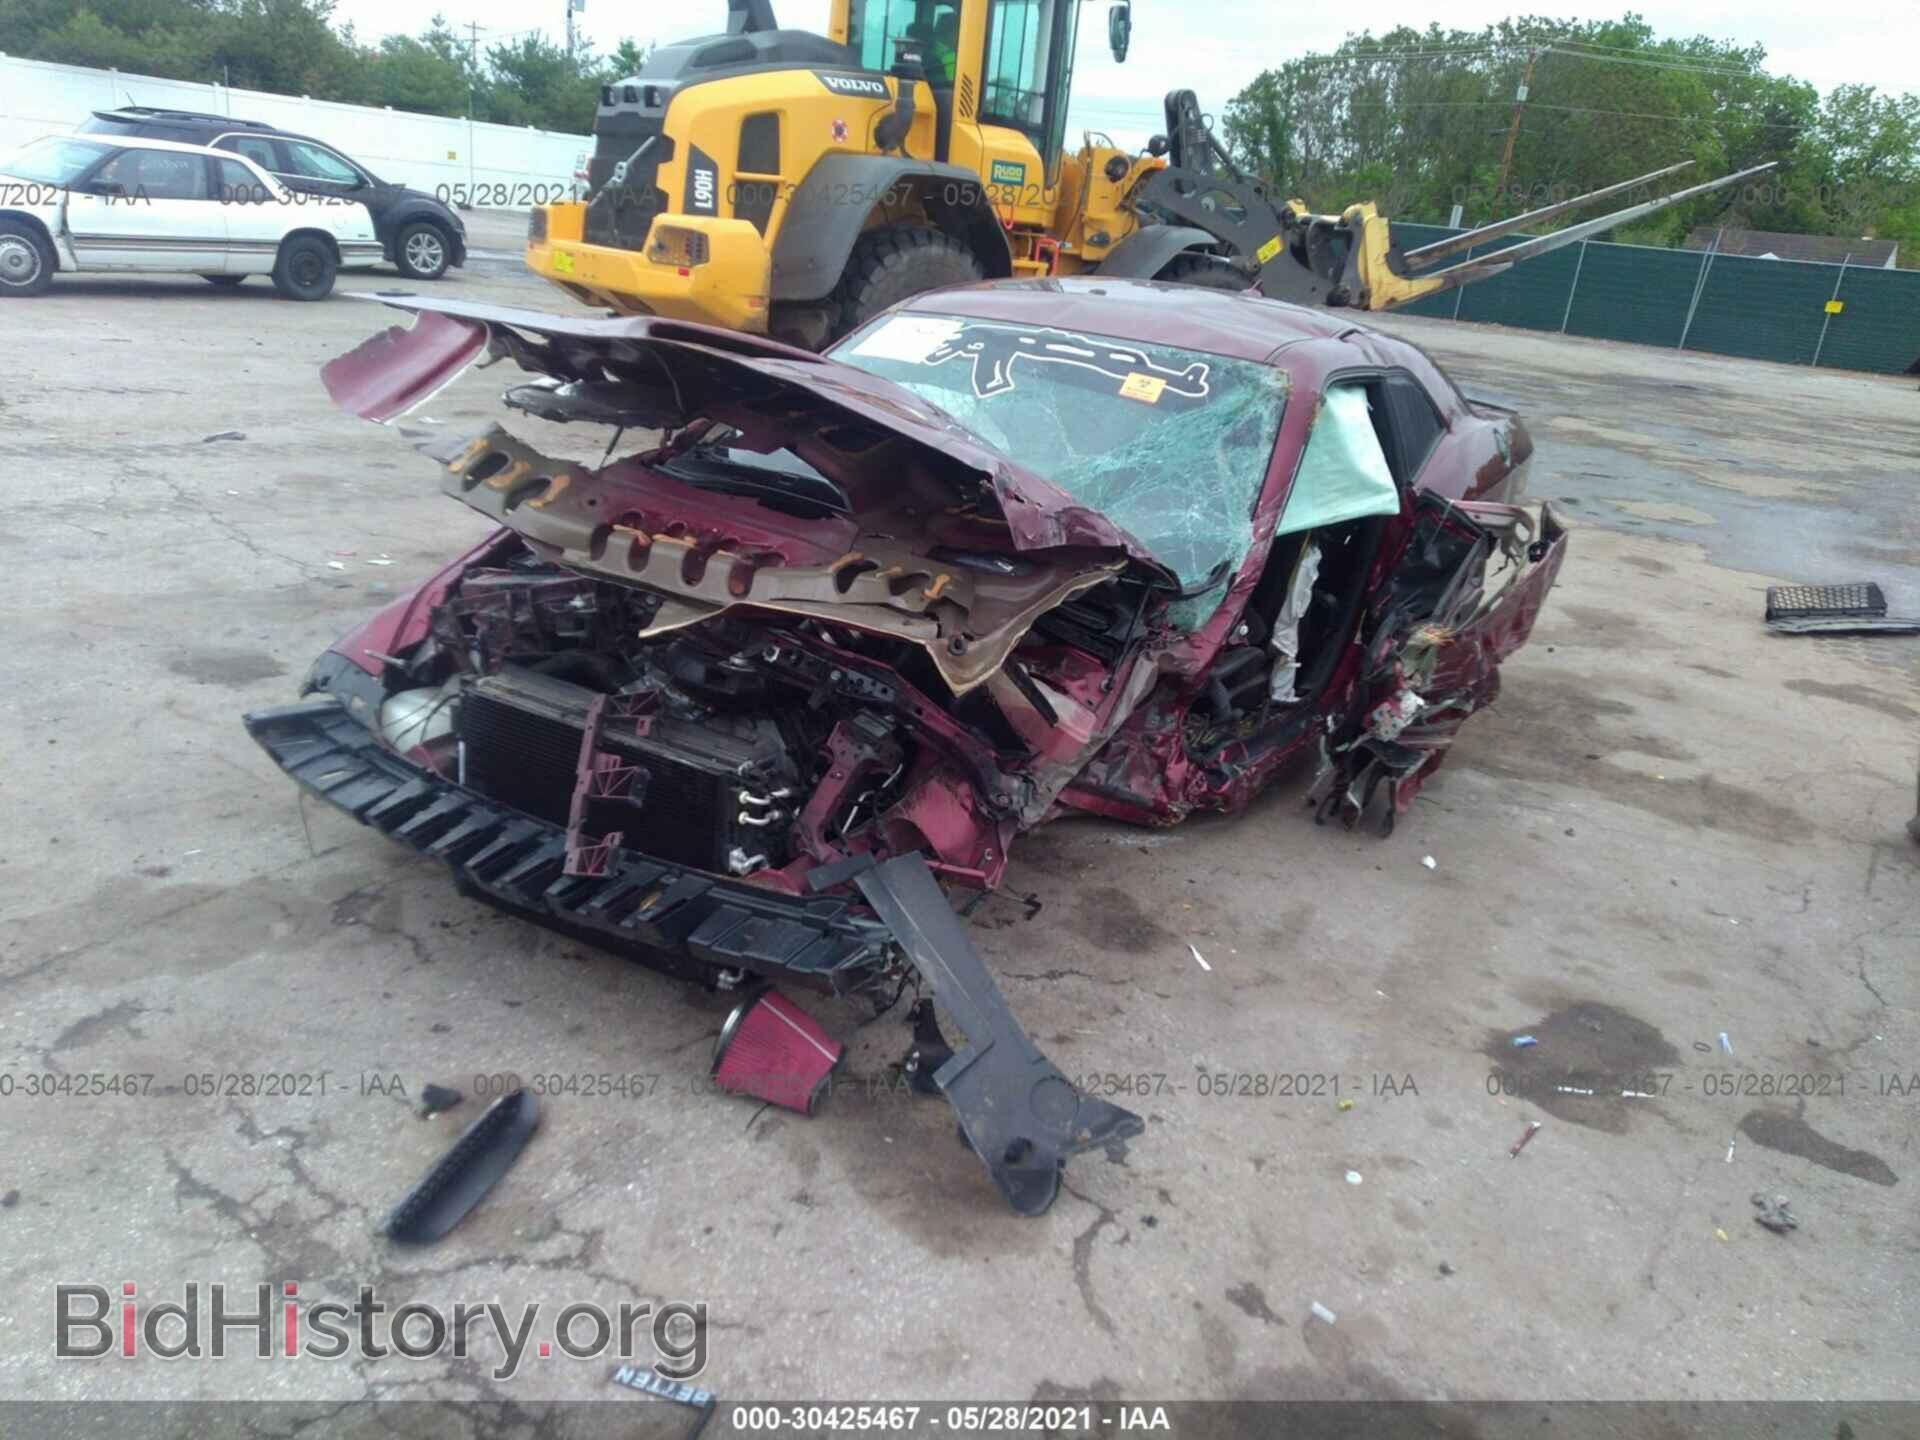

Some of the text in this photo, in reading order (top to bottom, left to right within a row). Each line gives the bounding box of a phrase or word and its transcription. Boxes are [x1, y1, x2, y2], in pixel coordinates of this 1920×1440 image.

[823, 76, 884, 93] VOLVO
[695, 169, 713, 209] L90H
[615, 1366, 711, 1408] BETTEN
